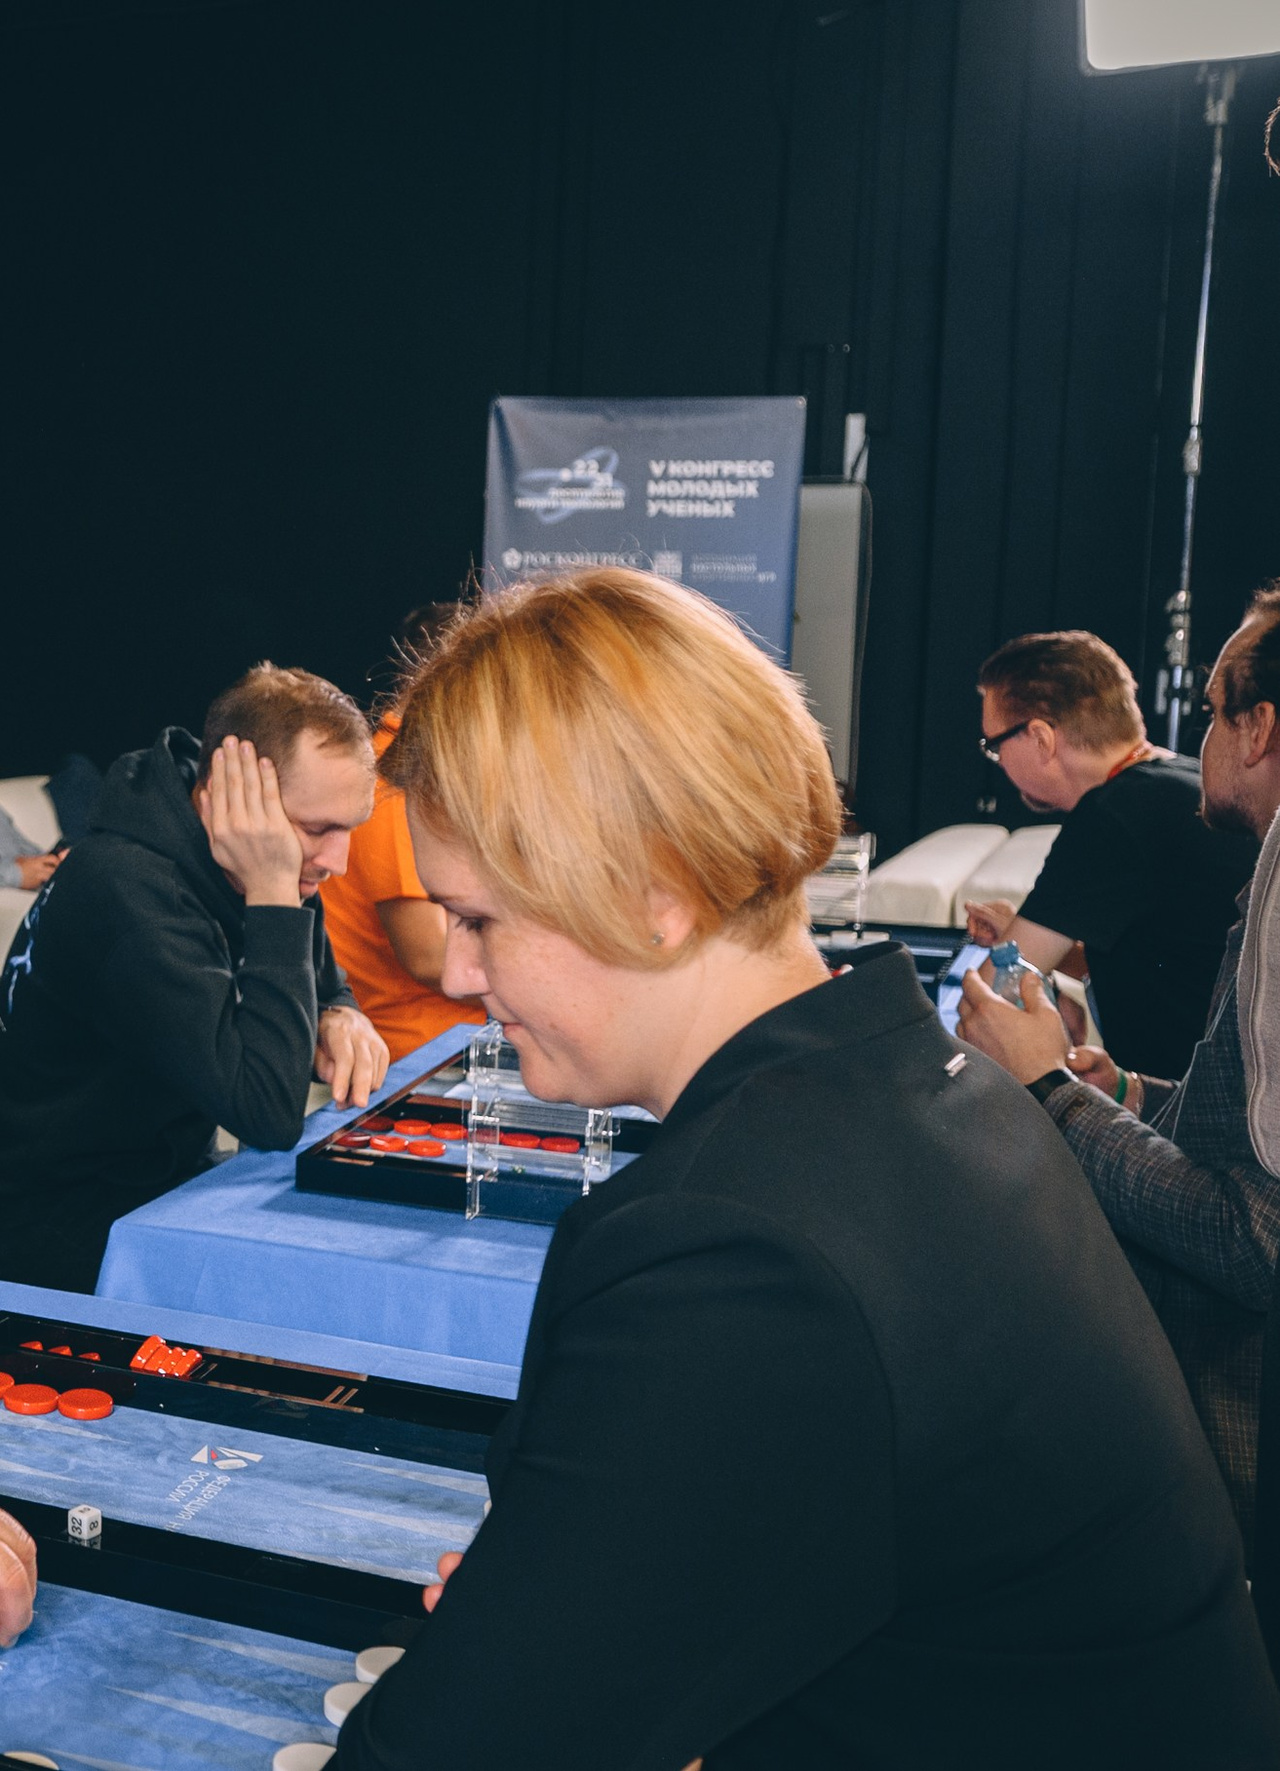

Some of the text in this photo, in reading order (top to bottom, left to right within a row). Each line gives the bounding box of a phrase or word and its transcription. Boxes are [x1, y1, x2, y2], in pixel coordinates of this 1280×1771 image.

[649, 459, 775, 479] V КОНГРЕСС
[646, 479, 759, 500] МОЛОДЫХ
[646, 499, 735, 518] УЧЕНЫХ
[168, 1469, 209, 1503] РОССИИ
[176, 1475, 231, 1520] ФЕДЕРАЦИЯ
[71, 1516, 82, 1535] 32
[89, 1520, 99, 1531] 8
